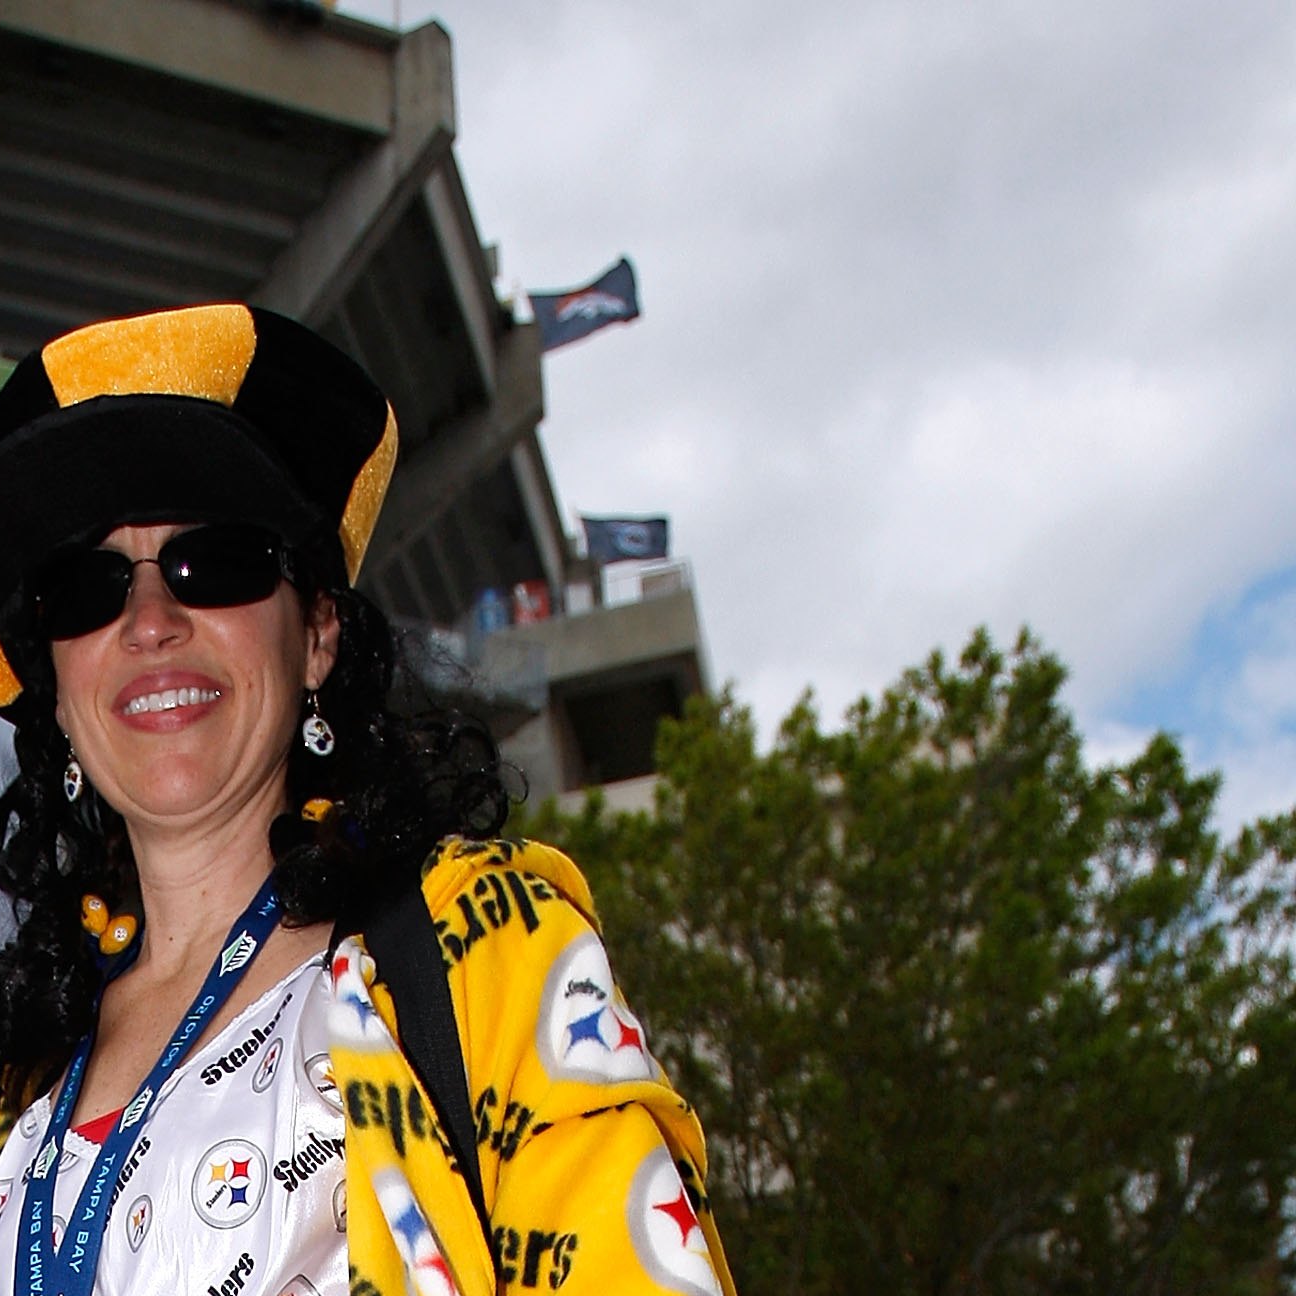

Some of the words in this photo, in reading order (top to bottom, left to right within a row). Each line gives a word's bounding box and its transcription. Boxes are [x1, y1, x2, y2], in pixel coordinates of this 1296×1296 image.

[200, 992, 294, 1086] Steelers
[82, 1152, 117, 1222] TAMPA
[30, 1200, 44, 1235] BAY
[68, 1231, 90, 1274] BAY
